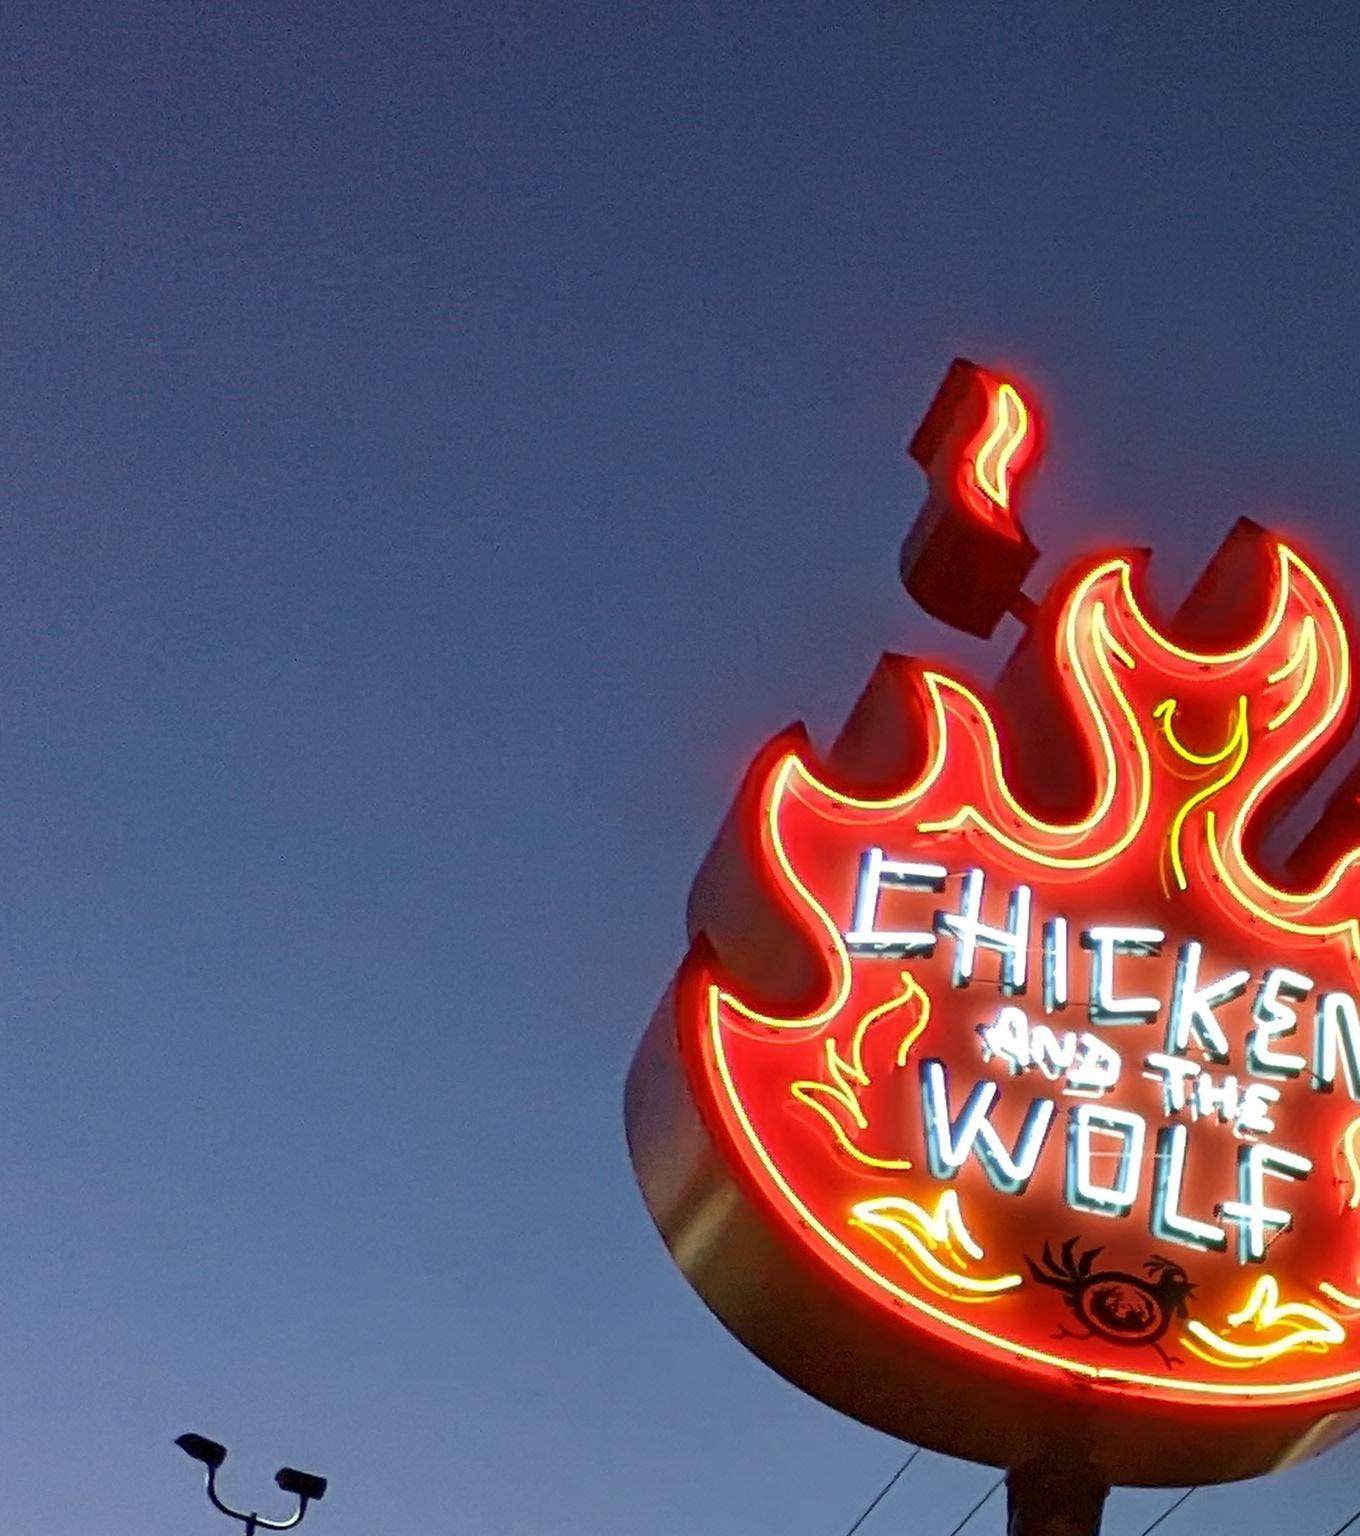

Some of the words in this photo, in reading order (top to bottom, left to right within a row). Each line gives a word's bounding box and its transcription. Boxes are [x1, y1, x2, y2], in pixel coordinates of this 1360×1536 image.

[977, 1006, 1122, 1096] AND
[1145, 1053, 1281, 1140] THE
[919, 1057, 1313, 1266] WOLF
